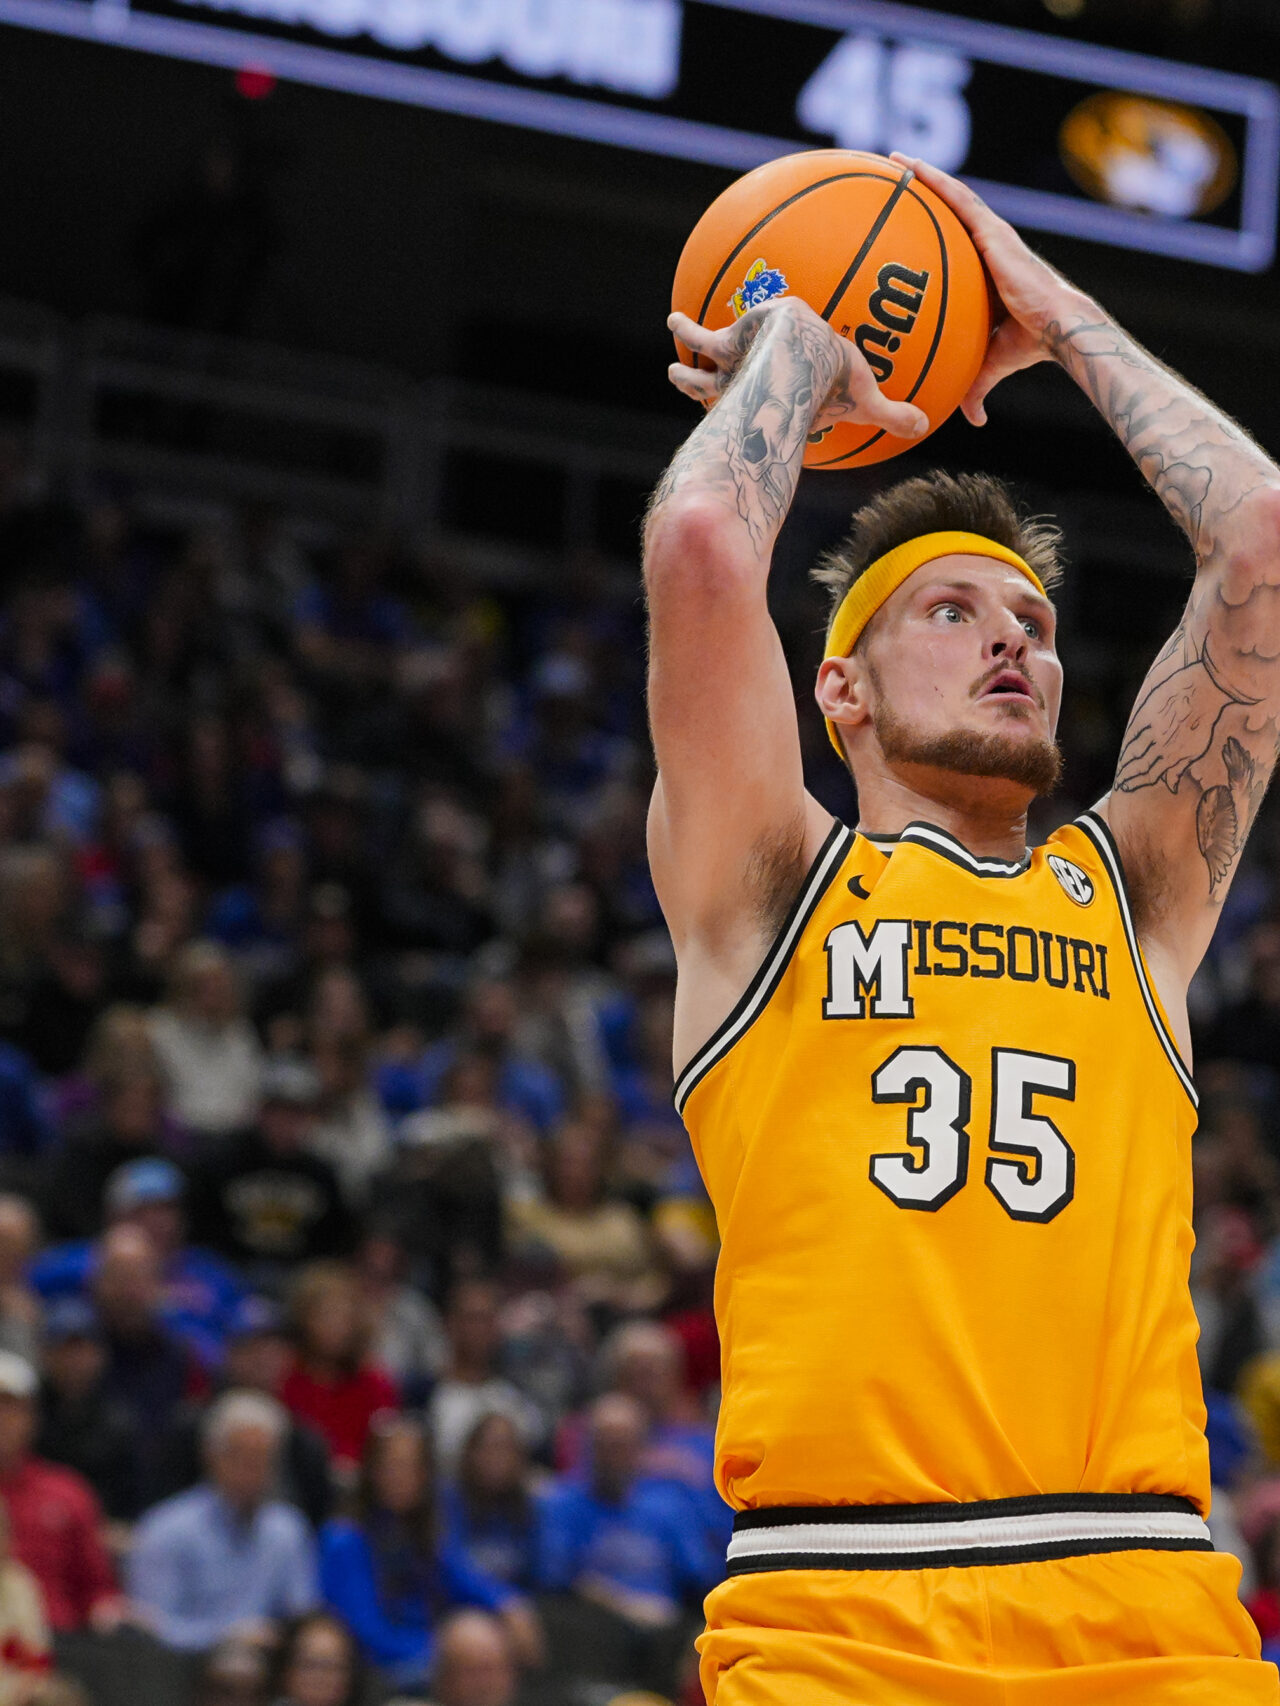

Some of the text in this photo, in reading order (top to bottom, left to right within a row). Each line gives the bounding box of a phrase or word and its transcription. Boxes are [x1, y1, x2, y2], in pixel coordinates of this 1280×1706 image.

[796, 31, 972, 173] 45
[1048, 855, 1093, 904] SEC
[822, 919, 1110, 1020] MISSOURI
[869, 1045, 1076, 1224] 35
